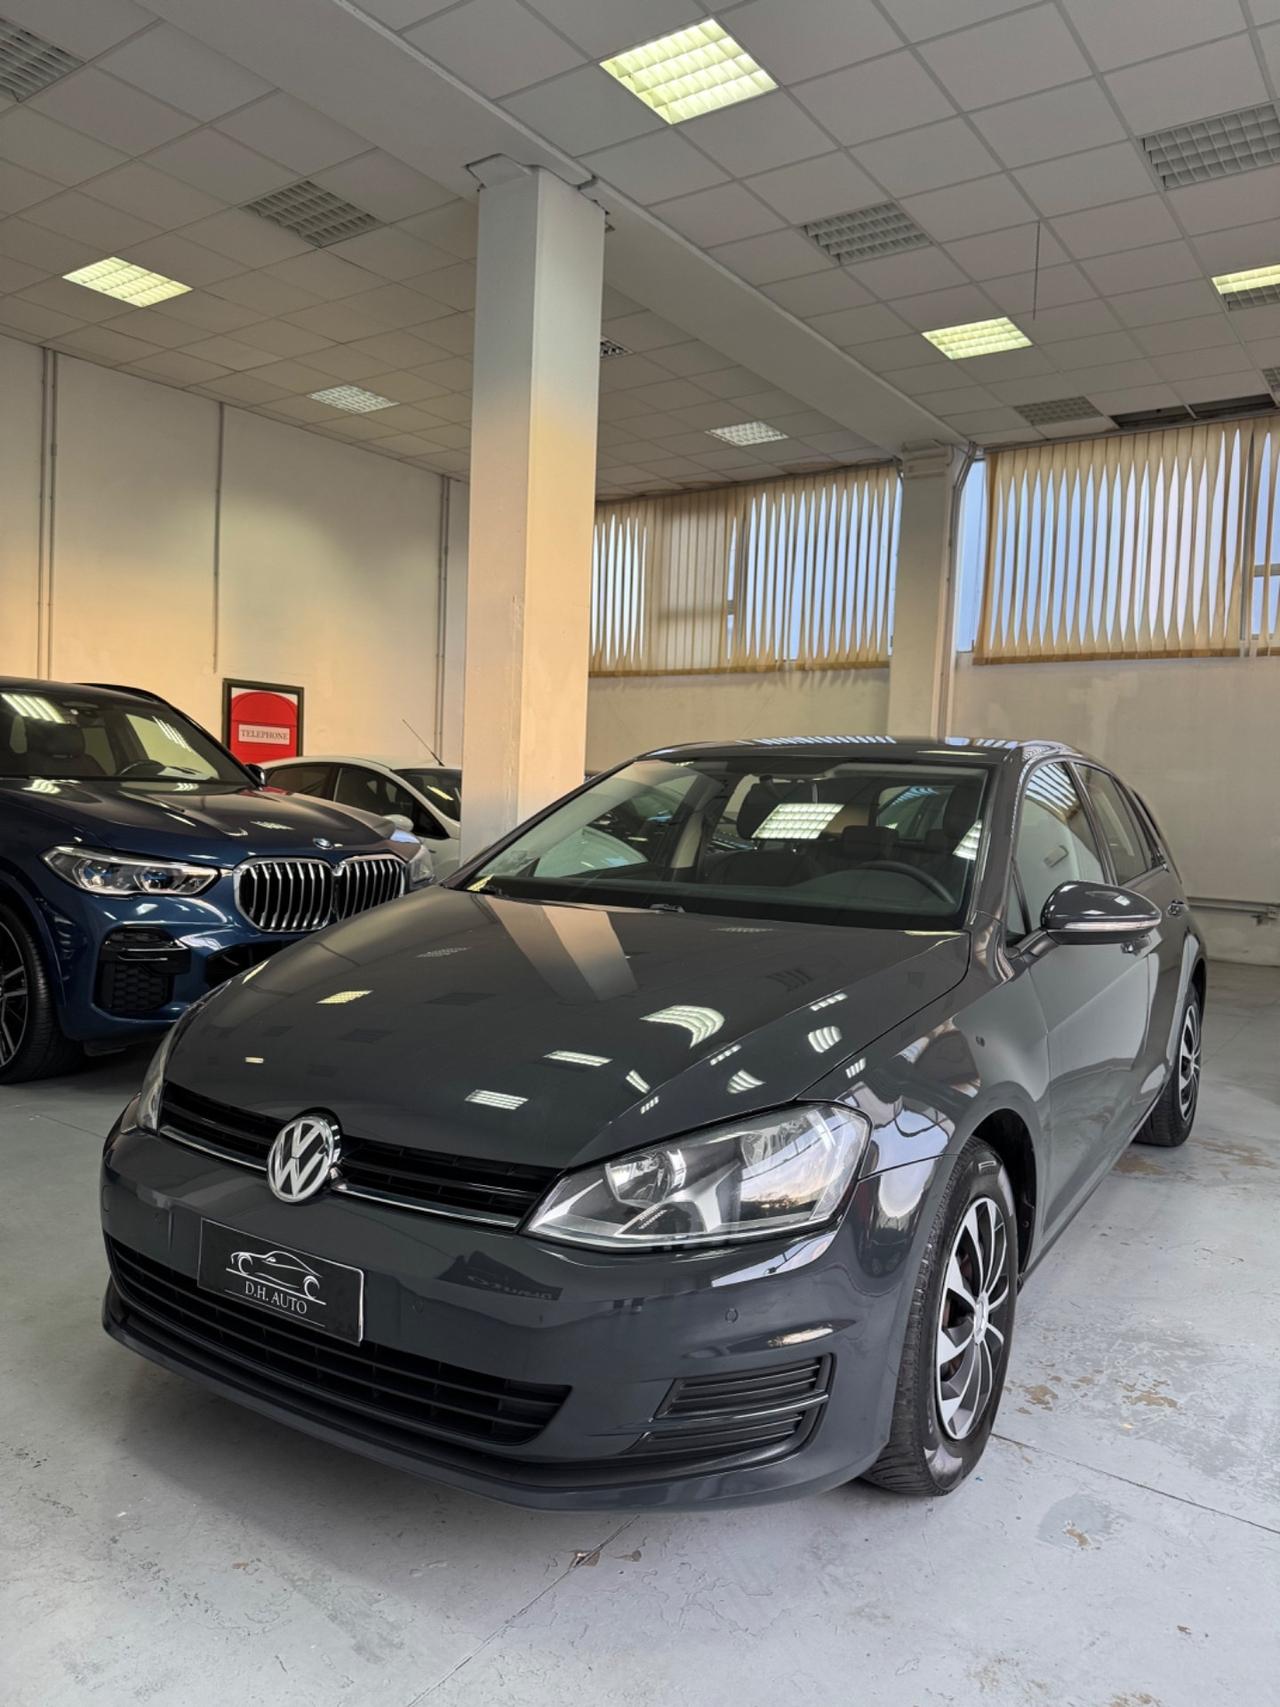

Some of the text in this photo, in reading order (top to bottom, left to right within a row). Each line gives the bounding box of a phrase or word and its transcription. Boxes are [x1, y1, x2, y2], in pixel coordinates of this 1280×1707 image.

[240, 729, 289, 741] TELEPHONE
[245, 1280, 307, 1314] D.H. AUTO
